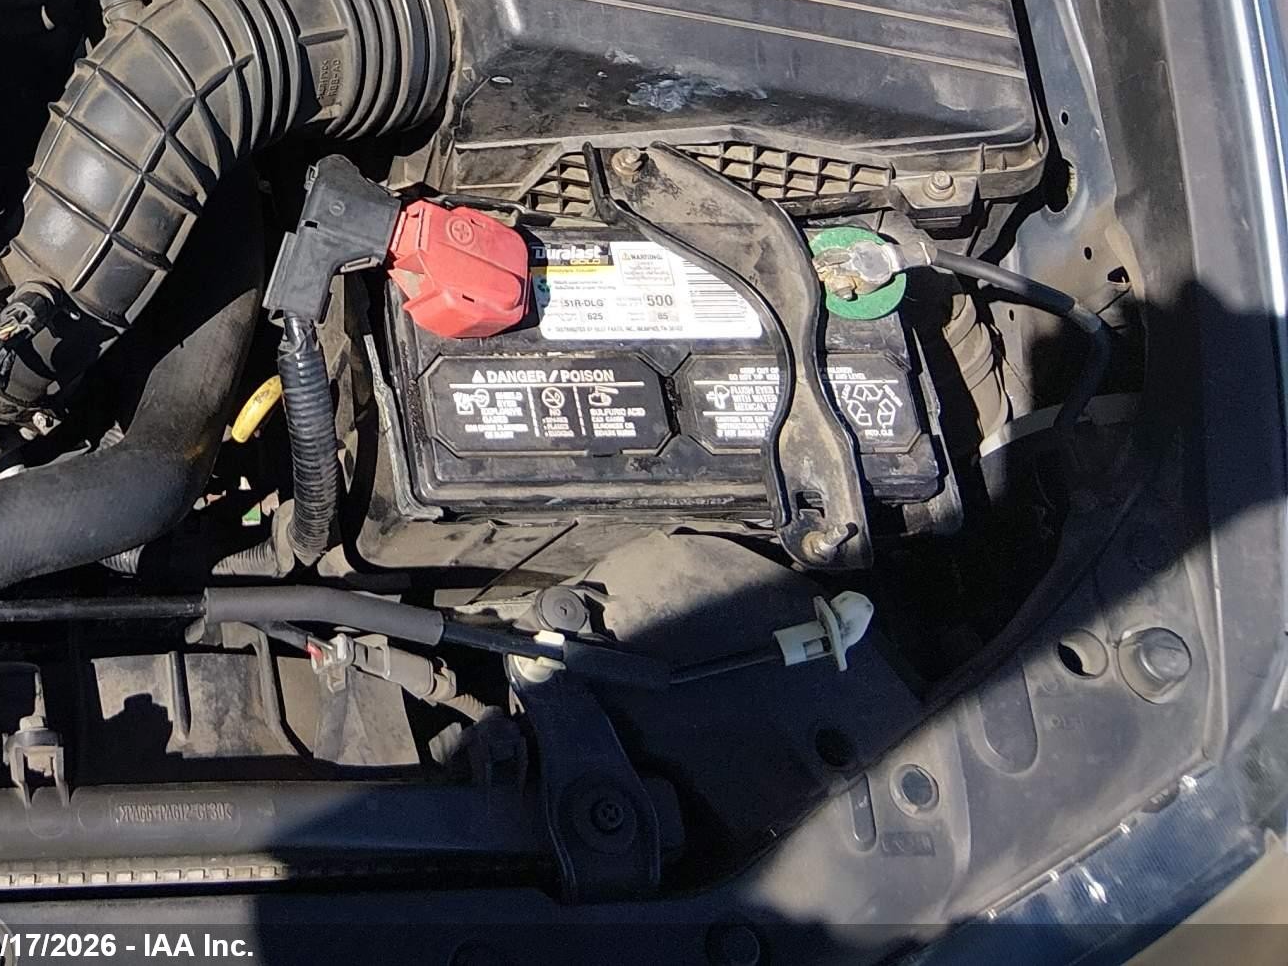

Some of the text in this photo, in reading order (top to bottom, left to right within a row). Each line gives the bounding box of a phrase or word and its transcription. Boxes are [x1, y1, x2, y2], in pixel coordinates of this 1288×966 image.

[532, 243, 602, 261] Duralast
[563, 298, 605, 308] 51R-DLG
[646, 294, 673, 307] 500
[587, 312, 604, 321] 625
[486, 369, 615, 384] DANGER / POISON
[730, 386, 755, 395] FLUSH
[752, 395, 778, 404] WATER
[627, 407, 646, 417] ACID
[734, 403, 766, 412] MEDICAL
[550, 408, 562, 417] NO
